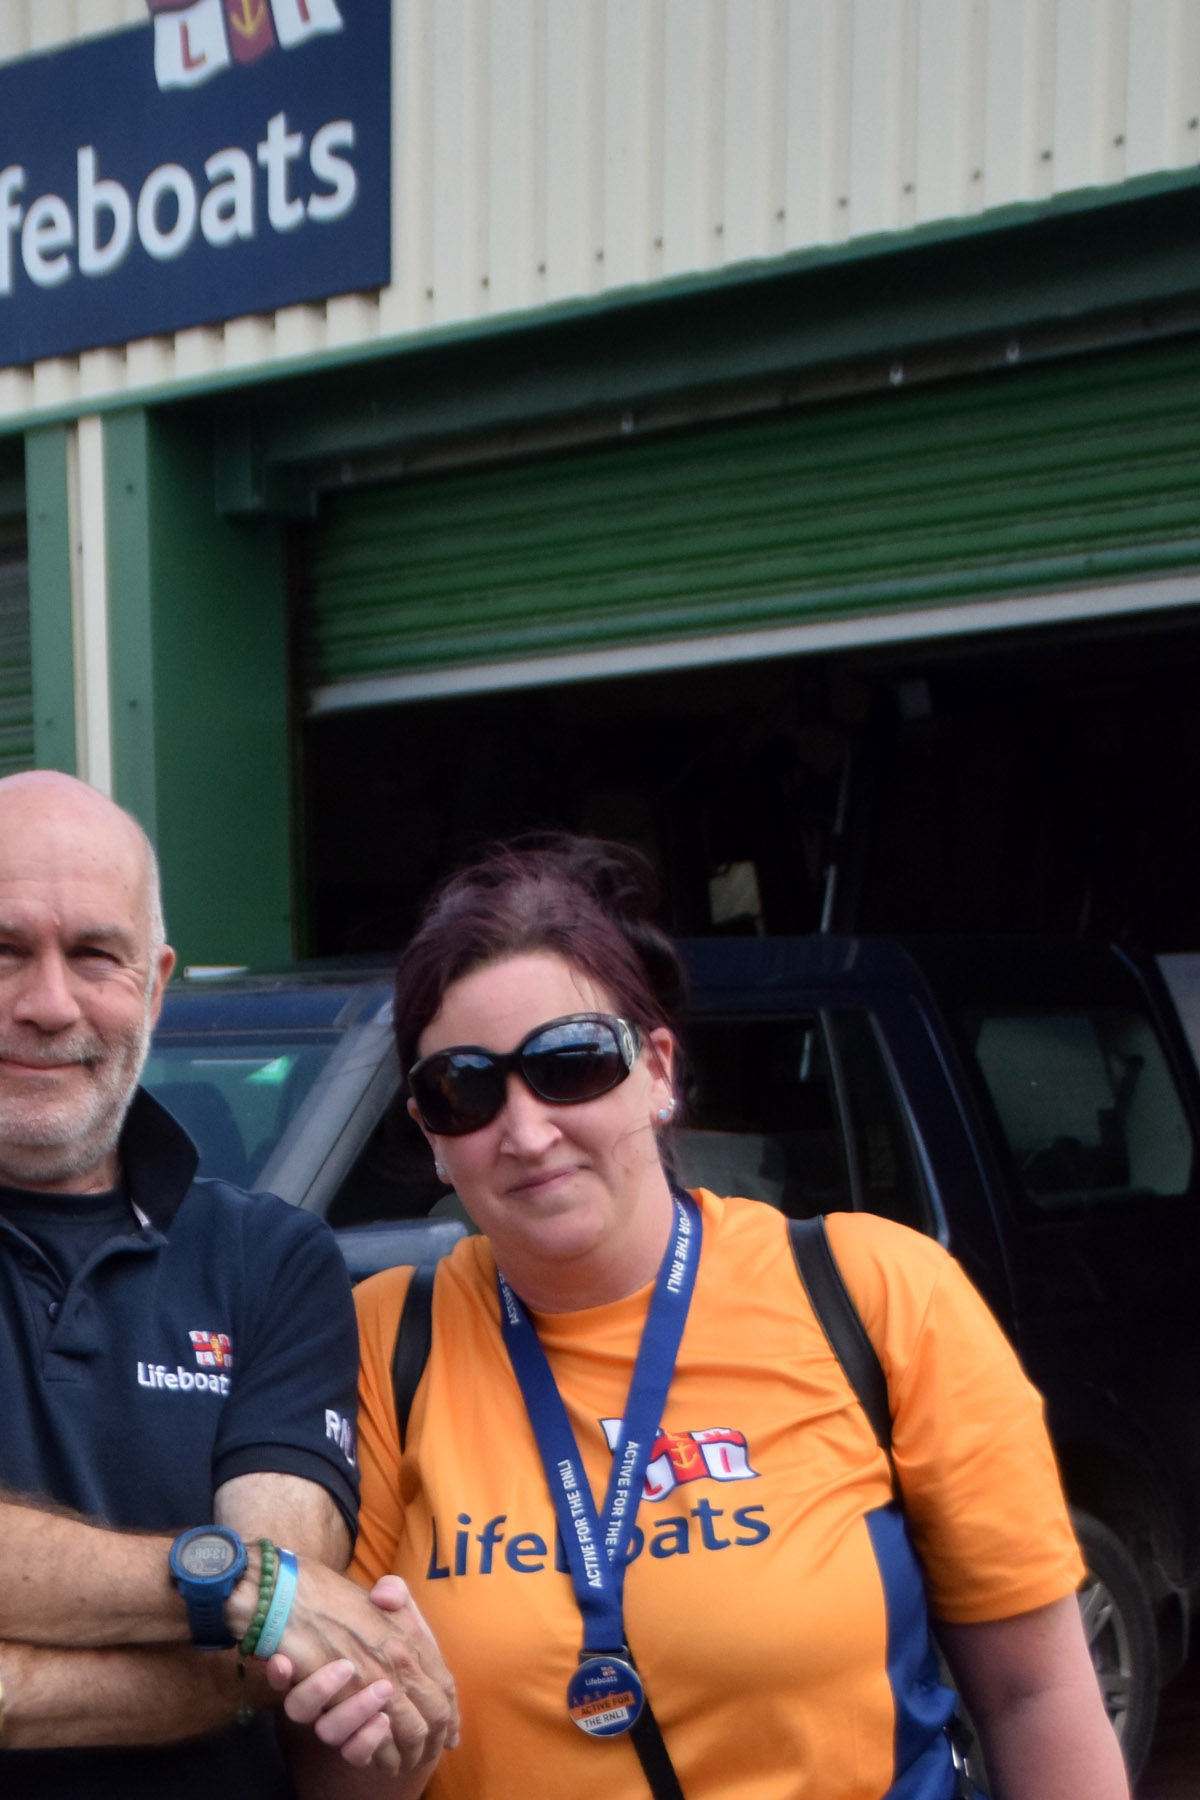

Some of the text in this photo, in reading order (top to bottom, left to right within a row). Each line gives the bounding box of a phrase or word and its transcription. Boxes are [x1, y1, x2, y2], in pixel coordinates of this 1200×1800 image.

[675, 1236, 689, 1260] THE
[667, 1260, 685, 1293] RNLI
[137, 1361, 231, 1396] Lifeboat
[618, 1440, 640, 1487] ACTIVE
[611, 1490, 628, 1516] FOR
[558, 1459, 603, 1588] ACTIVE FOR THE RNLI
[605, 1519, 622, 1545] THE
[581, 1694, 630, 1715] ACTIVE FOR
[584, 1710, 625, 1728] THE RNLI
